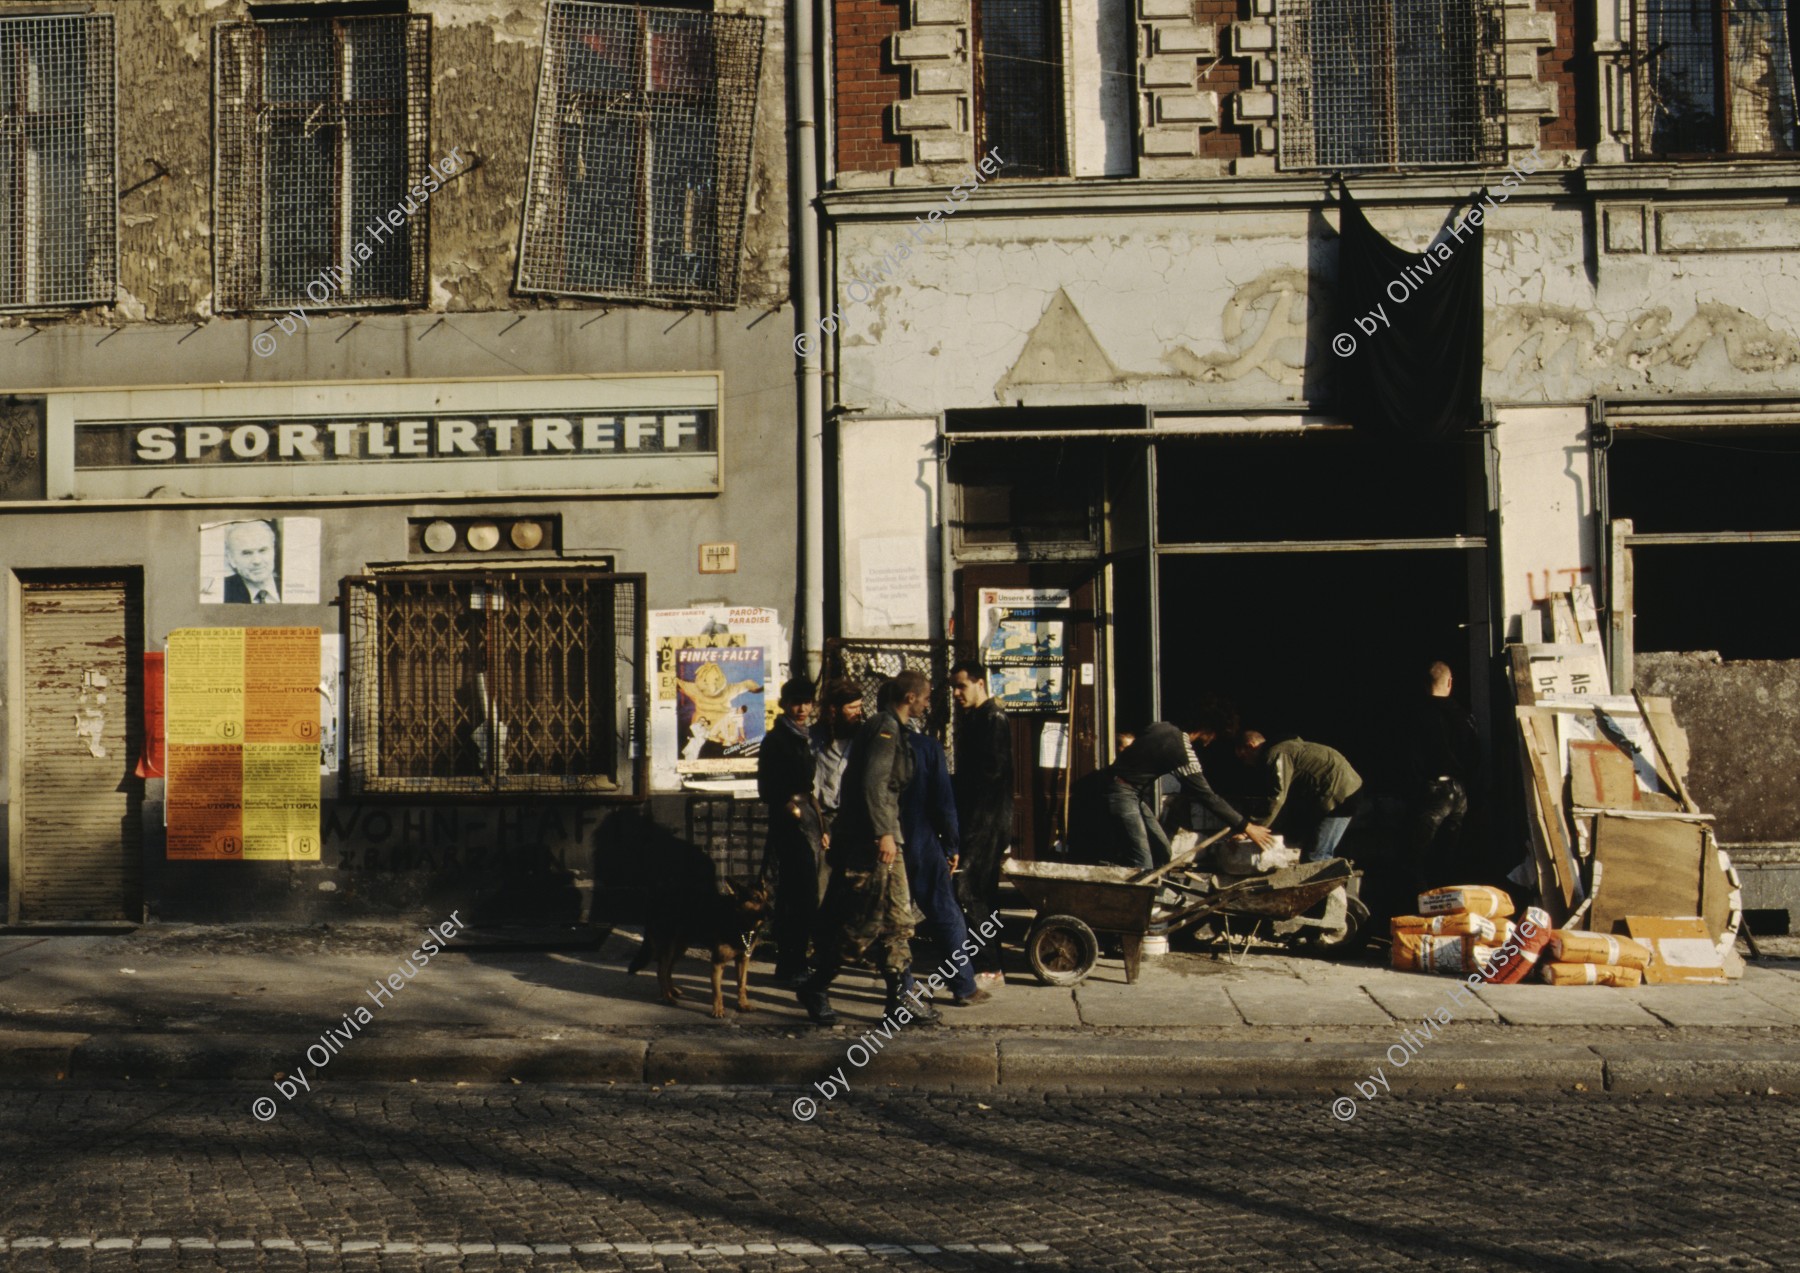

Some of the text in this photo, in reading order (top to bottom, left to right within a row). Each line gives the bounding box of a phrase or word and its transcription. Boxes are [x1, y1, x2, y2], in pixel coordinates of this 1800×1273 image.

[136, 414, 698, 461] SPORTLERTREFF
[729, 607, 764, 617] PARODY
[728, 616, 771, 625] PARADISE
[1569, 673, 1591, 695] Als
[207, 802, 242, 810] UTOPIA
[283, 802, 319, 810] UTOPIA
